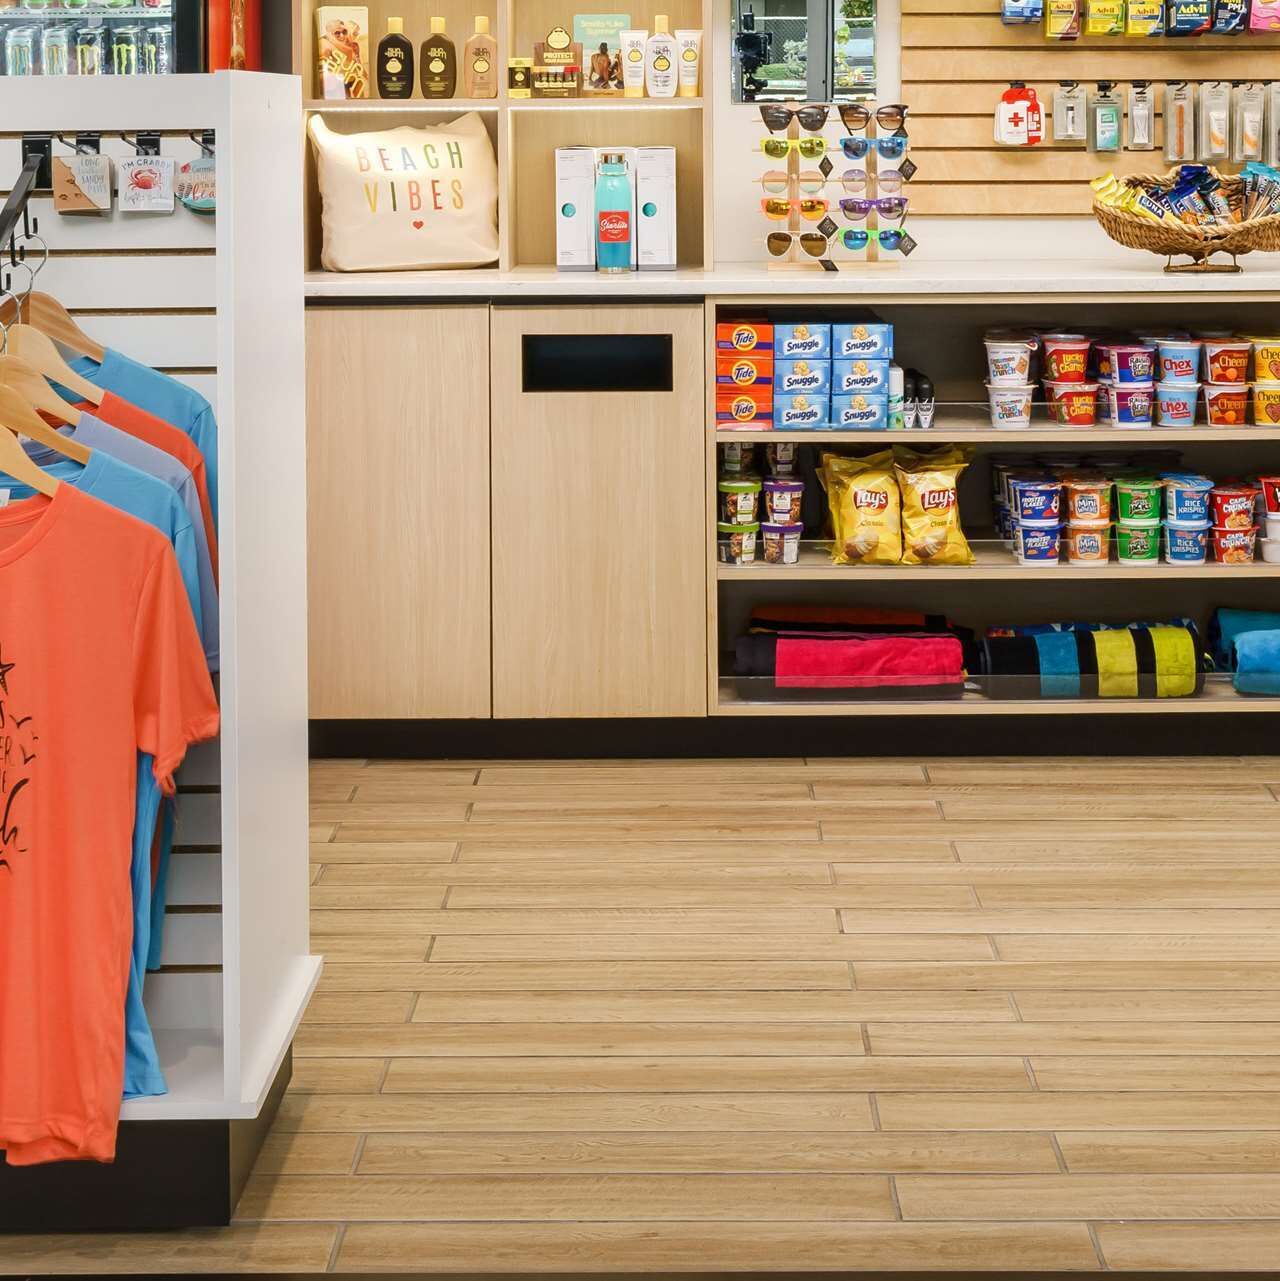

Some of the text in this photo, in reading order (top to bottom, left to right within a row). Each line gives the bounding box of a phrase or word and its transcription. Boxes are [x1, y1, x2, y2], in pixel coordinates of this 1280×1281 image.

[1096, 6, 1114, 14] Advil
[1136, 7, 1155, 15] Advil
[1178, 3, 1208, 14] Advil
[1228, 3, 1243, 12] PM
[355, 141, 464, 172] BEACH
[122, 160, 134, 170] I'M
[363, 178, 465, 214] VIBES
[1139, 195, 1166, 219] LUNA
[735, 332, 755, 346] Tide
[786, 341, 820, 352] Snuggle
[845, 340, 878, 352] Snuggle
[1163, 359, 1192, 371] Chex
[734, 367, 754, 381] Tide
[786, 376, 820, 387] Snuggle
[845, 375, 878, 387] Snuggle
[734, 402, 754, 416] Tide
[1069, 405, 1095, 417] Charms
[1160, 401, 1188, 413] Chex
[785, 410, 819, 421] Snuggle
[844, 409, 877, 421] Snuggle
[1022, 495, 1046, 503] FROSTED
[1078, 499, 1096, 507] Mini
[1222, 502, 1251, 513] CRUNCH
[1080, 540, 1098, 548] Mini
[1177, 539, 1193, 547] RICE
[1220, 538, 1249, 548] CRUNCH
[1171, 546, 1200, 554] KRISPIES
